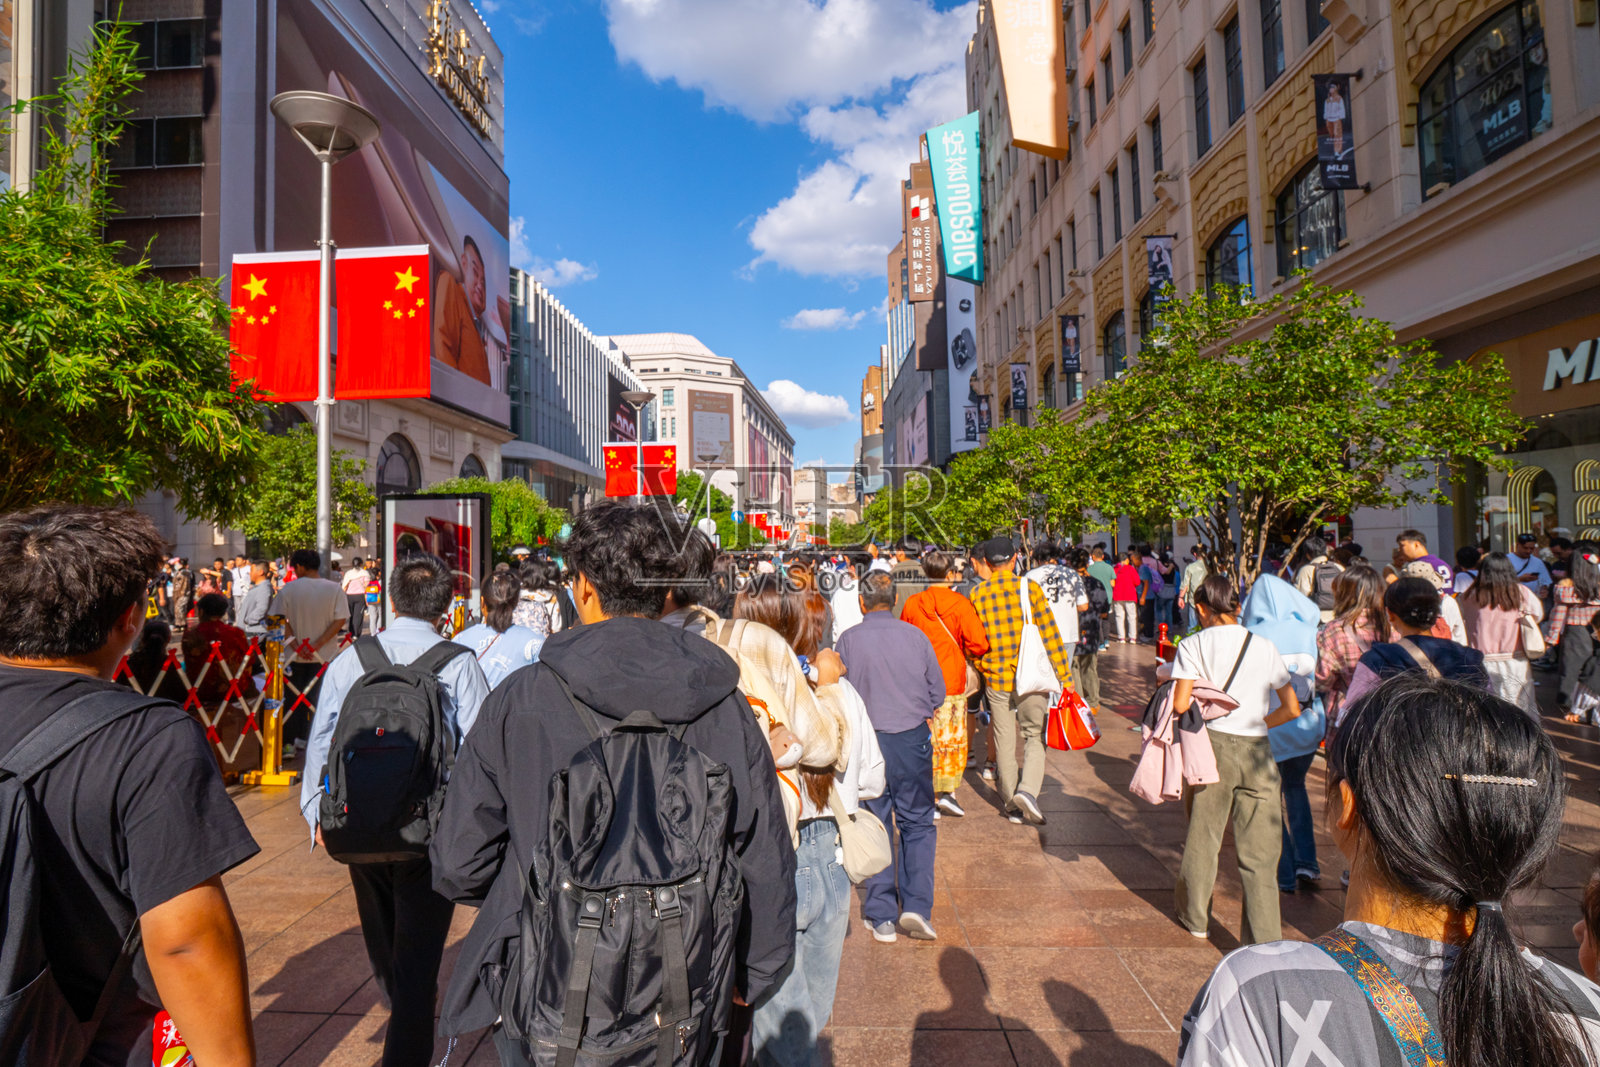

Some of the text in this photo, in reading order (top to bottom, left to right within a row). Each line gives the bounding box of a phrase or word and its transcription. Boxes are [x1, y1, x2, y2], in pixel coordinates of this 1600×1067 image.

[1482, 99, 1521, 136] MLB
[1326, 164, 1349, 173] MLB
[923, 226, 933, 295] HONGYI PLAZA
